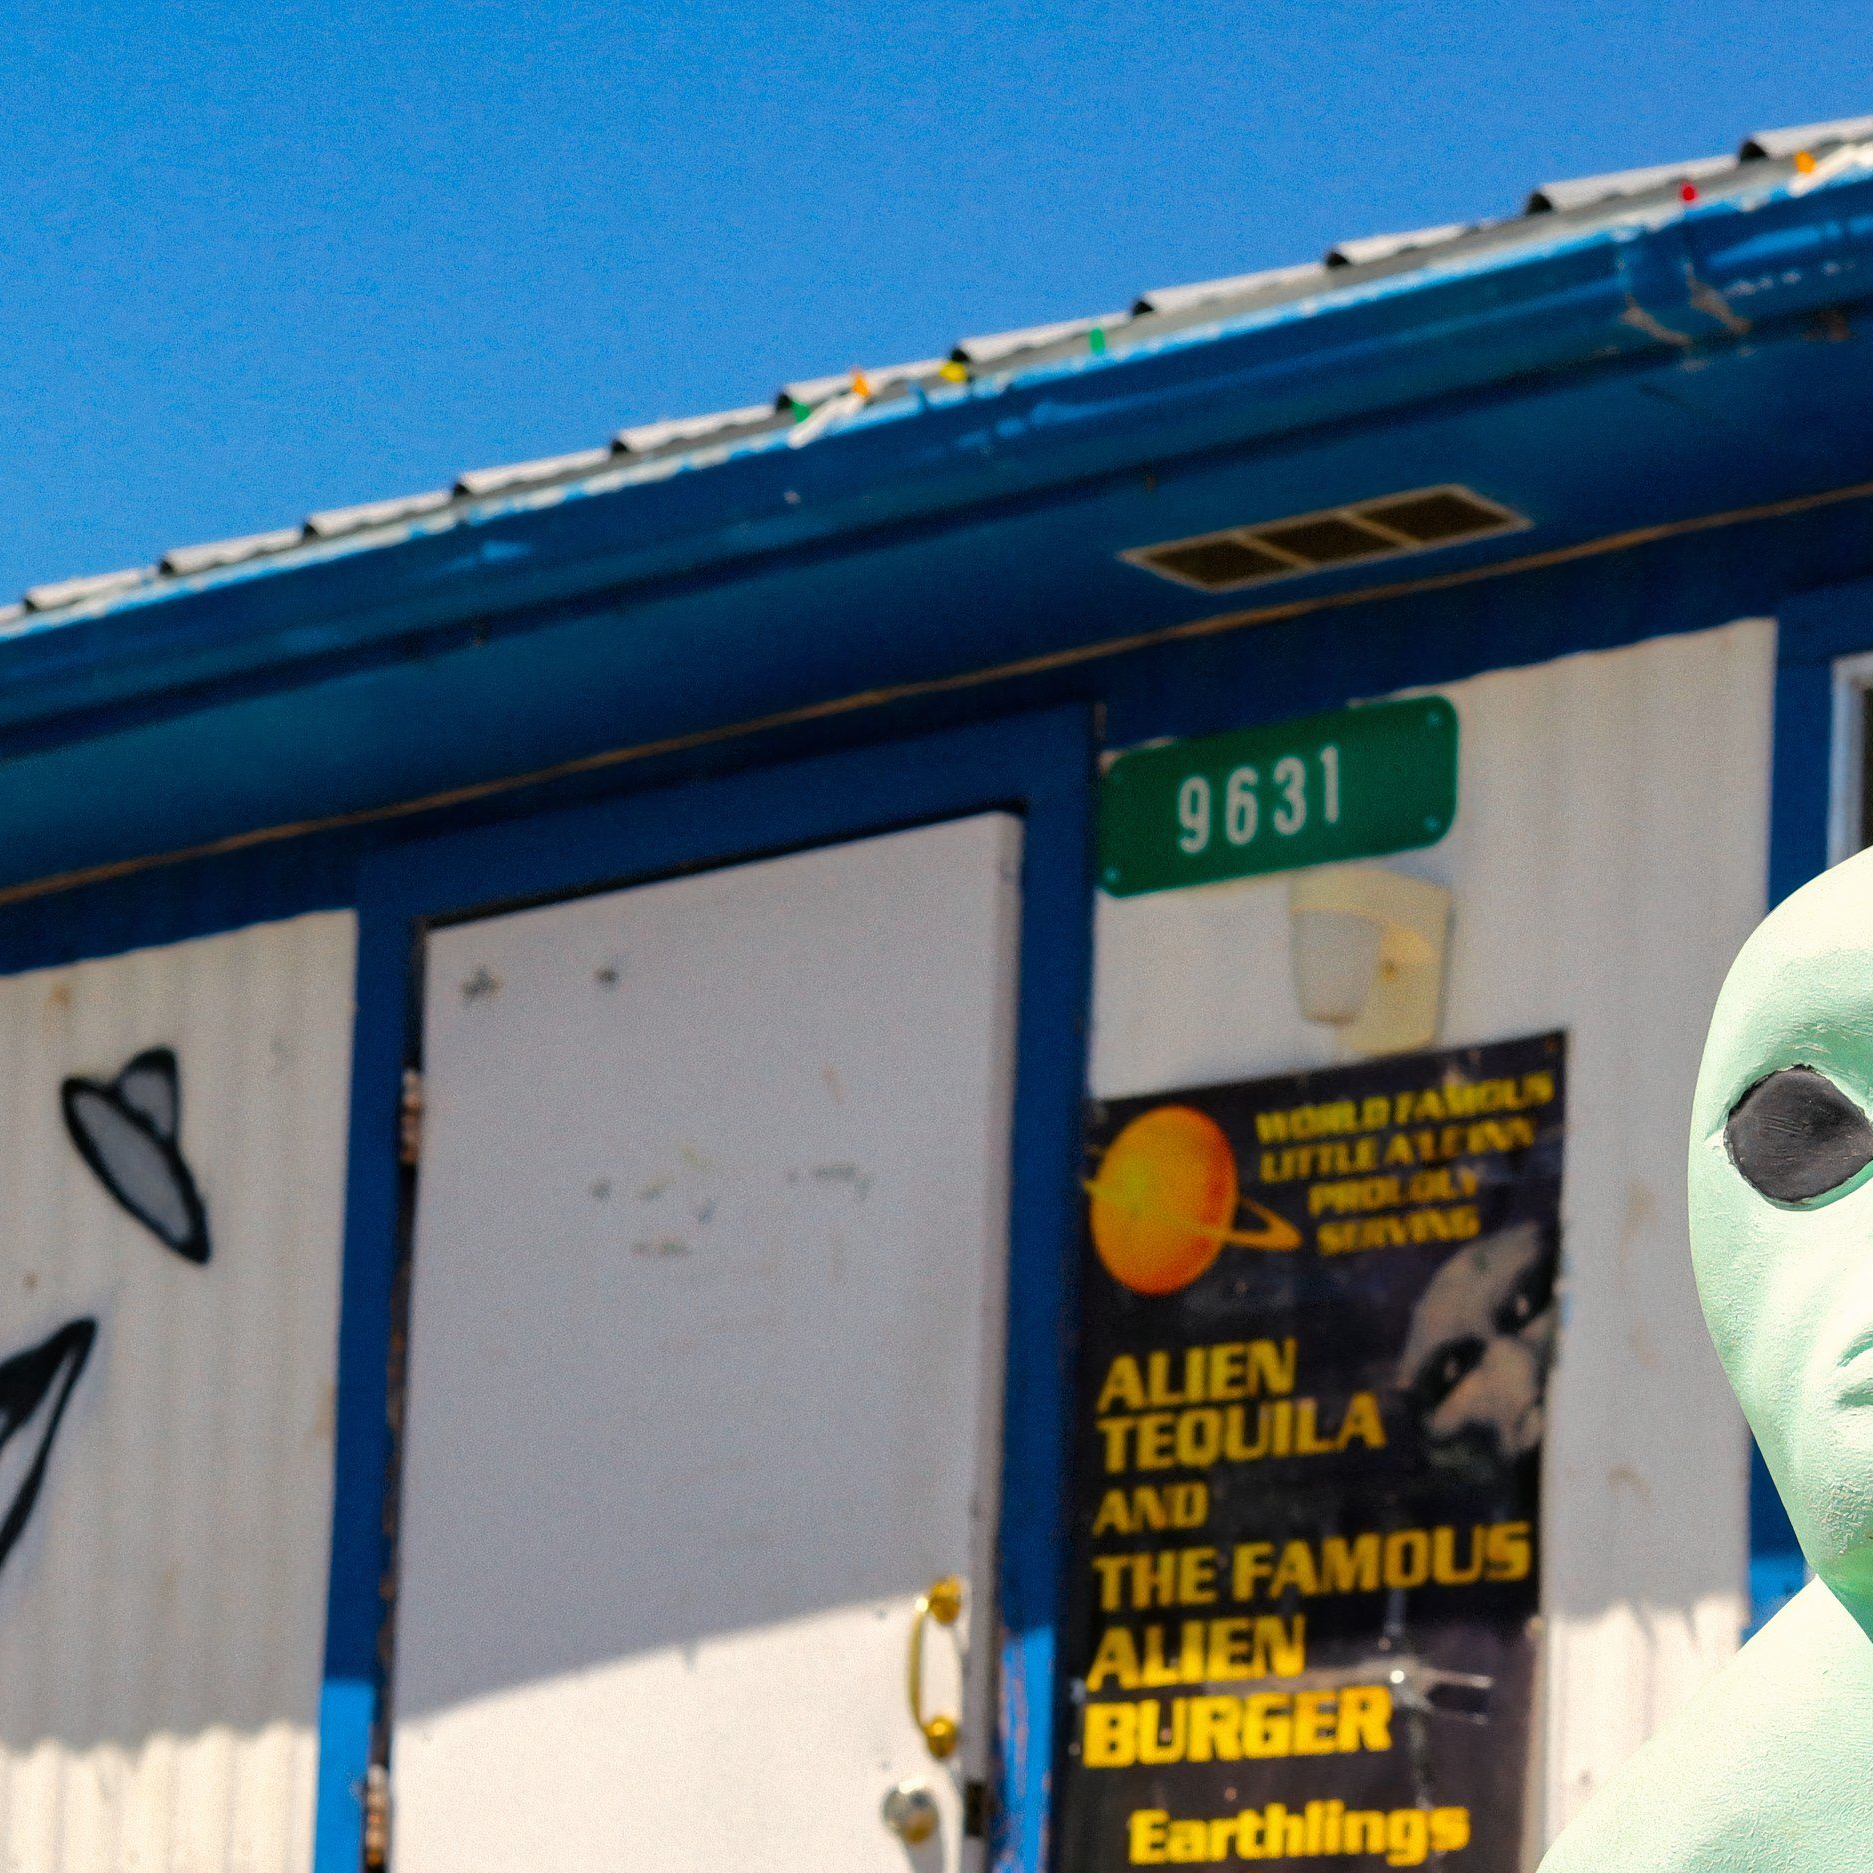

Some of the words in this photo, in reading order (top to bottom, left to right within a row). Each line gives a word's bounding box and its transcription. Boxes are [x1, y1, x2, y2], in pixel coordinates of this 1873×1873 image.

[1178, 745, 1340, 855] 9631
[1255, 1095, 1391, 1144] WORLD
[1394, 1070, 1555, 1125] FAMOUS
[1259, 1135, 1377, 1183] LITTLE
[1308, 1166, 1478, 1218] PROUDLY
[1316, 1205, 1481, 1257] SERVING
[1096, 1336, 1298, 1414] ALIEN
[1096, 1391, 1387, 1474] TEQUILA
[1091, 1480, 1209, 1537] AND
[1091, 1546, 1218, 1613] THE
[1232, 1521, 1531, 1601] FAMOUS
[1085, 1613, 1306, 1692] ALIEN
[1082, 1685, 1393, 1769] BURGER
[1129, 1799, 1471, 1868] Earthlings
